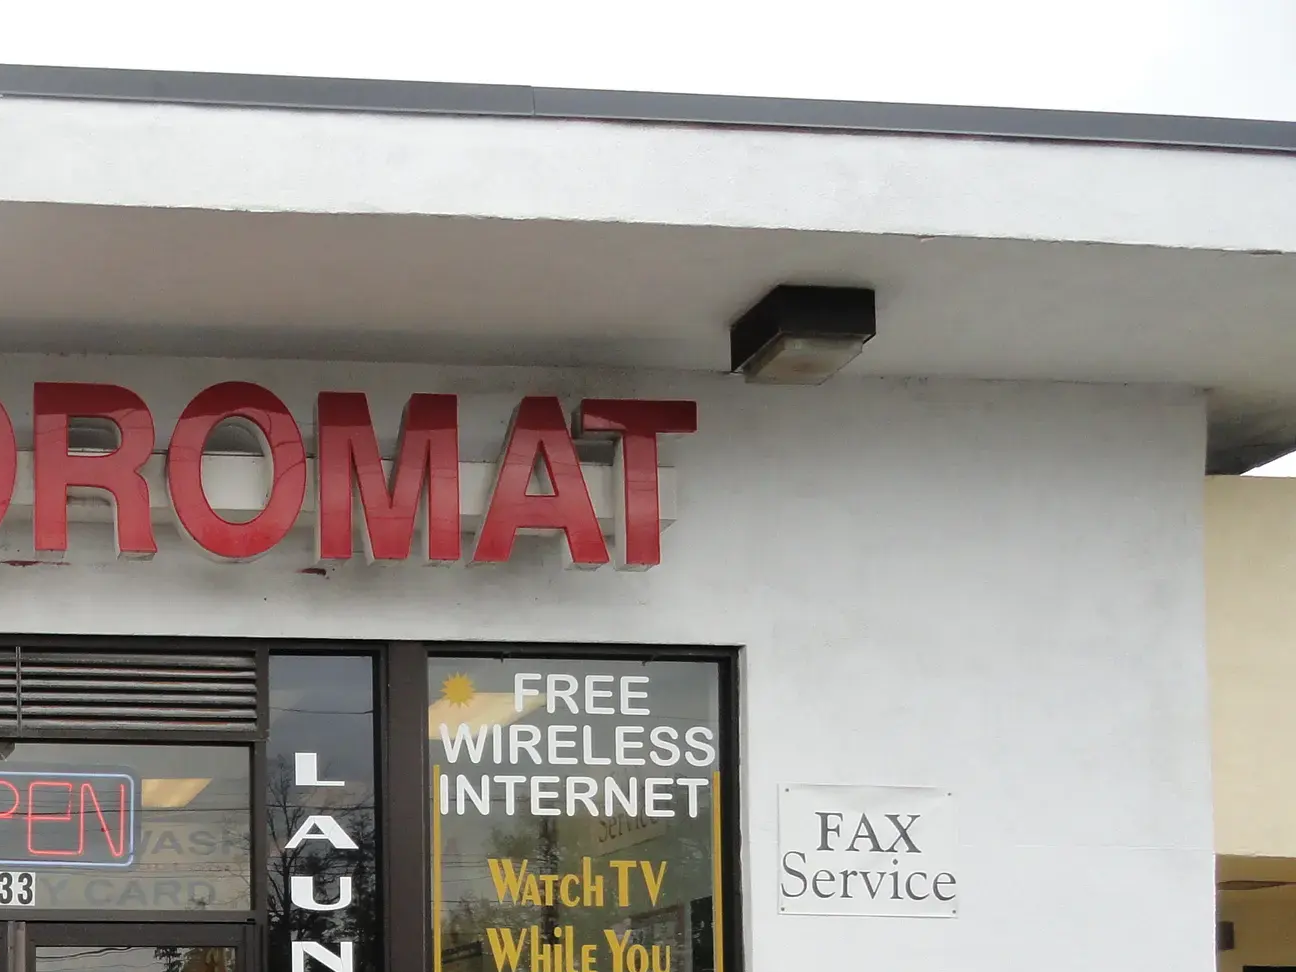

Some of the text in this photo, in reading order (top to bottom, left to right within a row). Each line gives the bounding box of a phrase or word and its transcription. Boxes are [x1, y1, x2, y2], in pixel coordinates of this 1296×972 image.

[514, 672, 651, 716] FREE
[439, 722, 716, 767] WIRELESS
[440, 773, 710, 819] INTERNET
[814, 811, 922, 853] FAX
[84, 878, 216, 906] CARD
[609, 860, 668, 907] TV
[781, 851, 956, 901] Service
